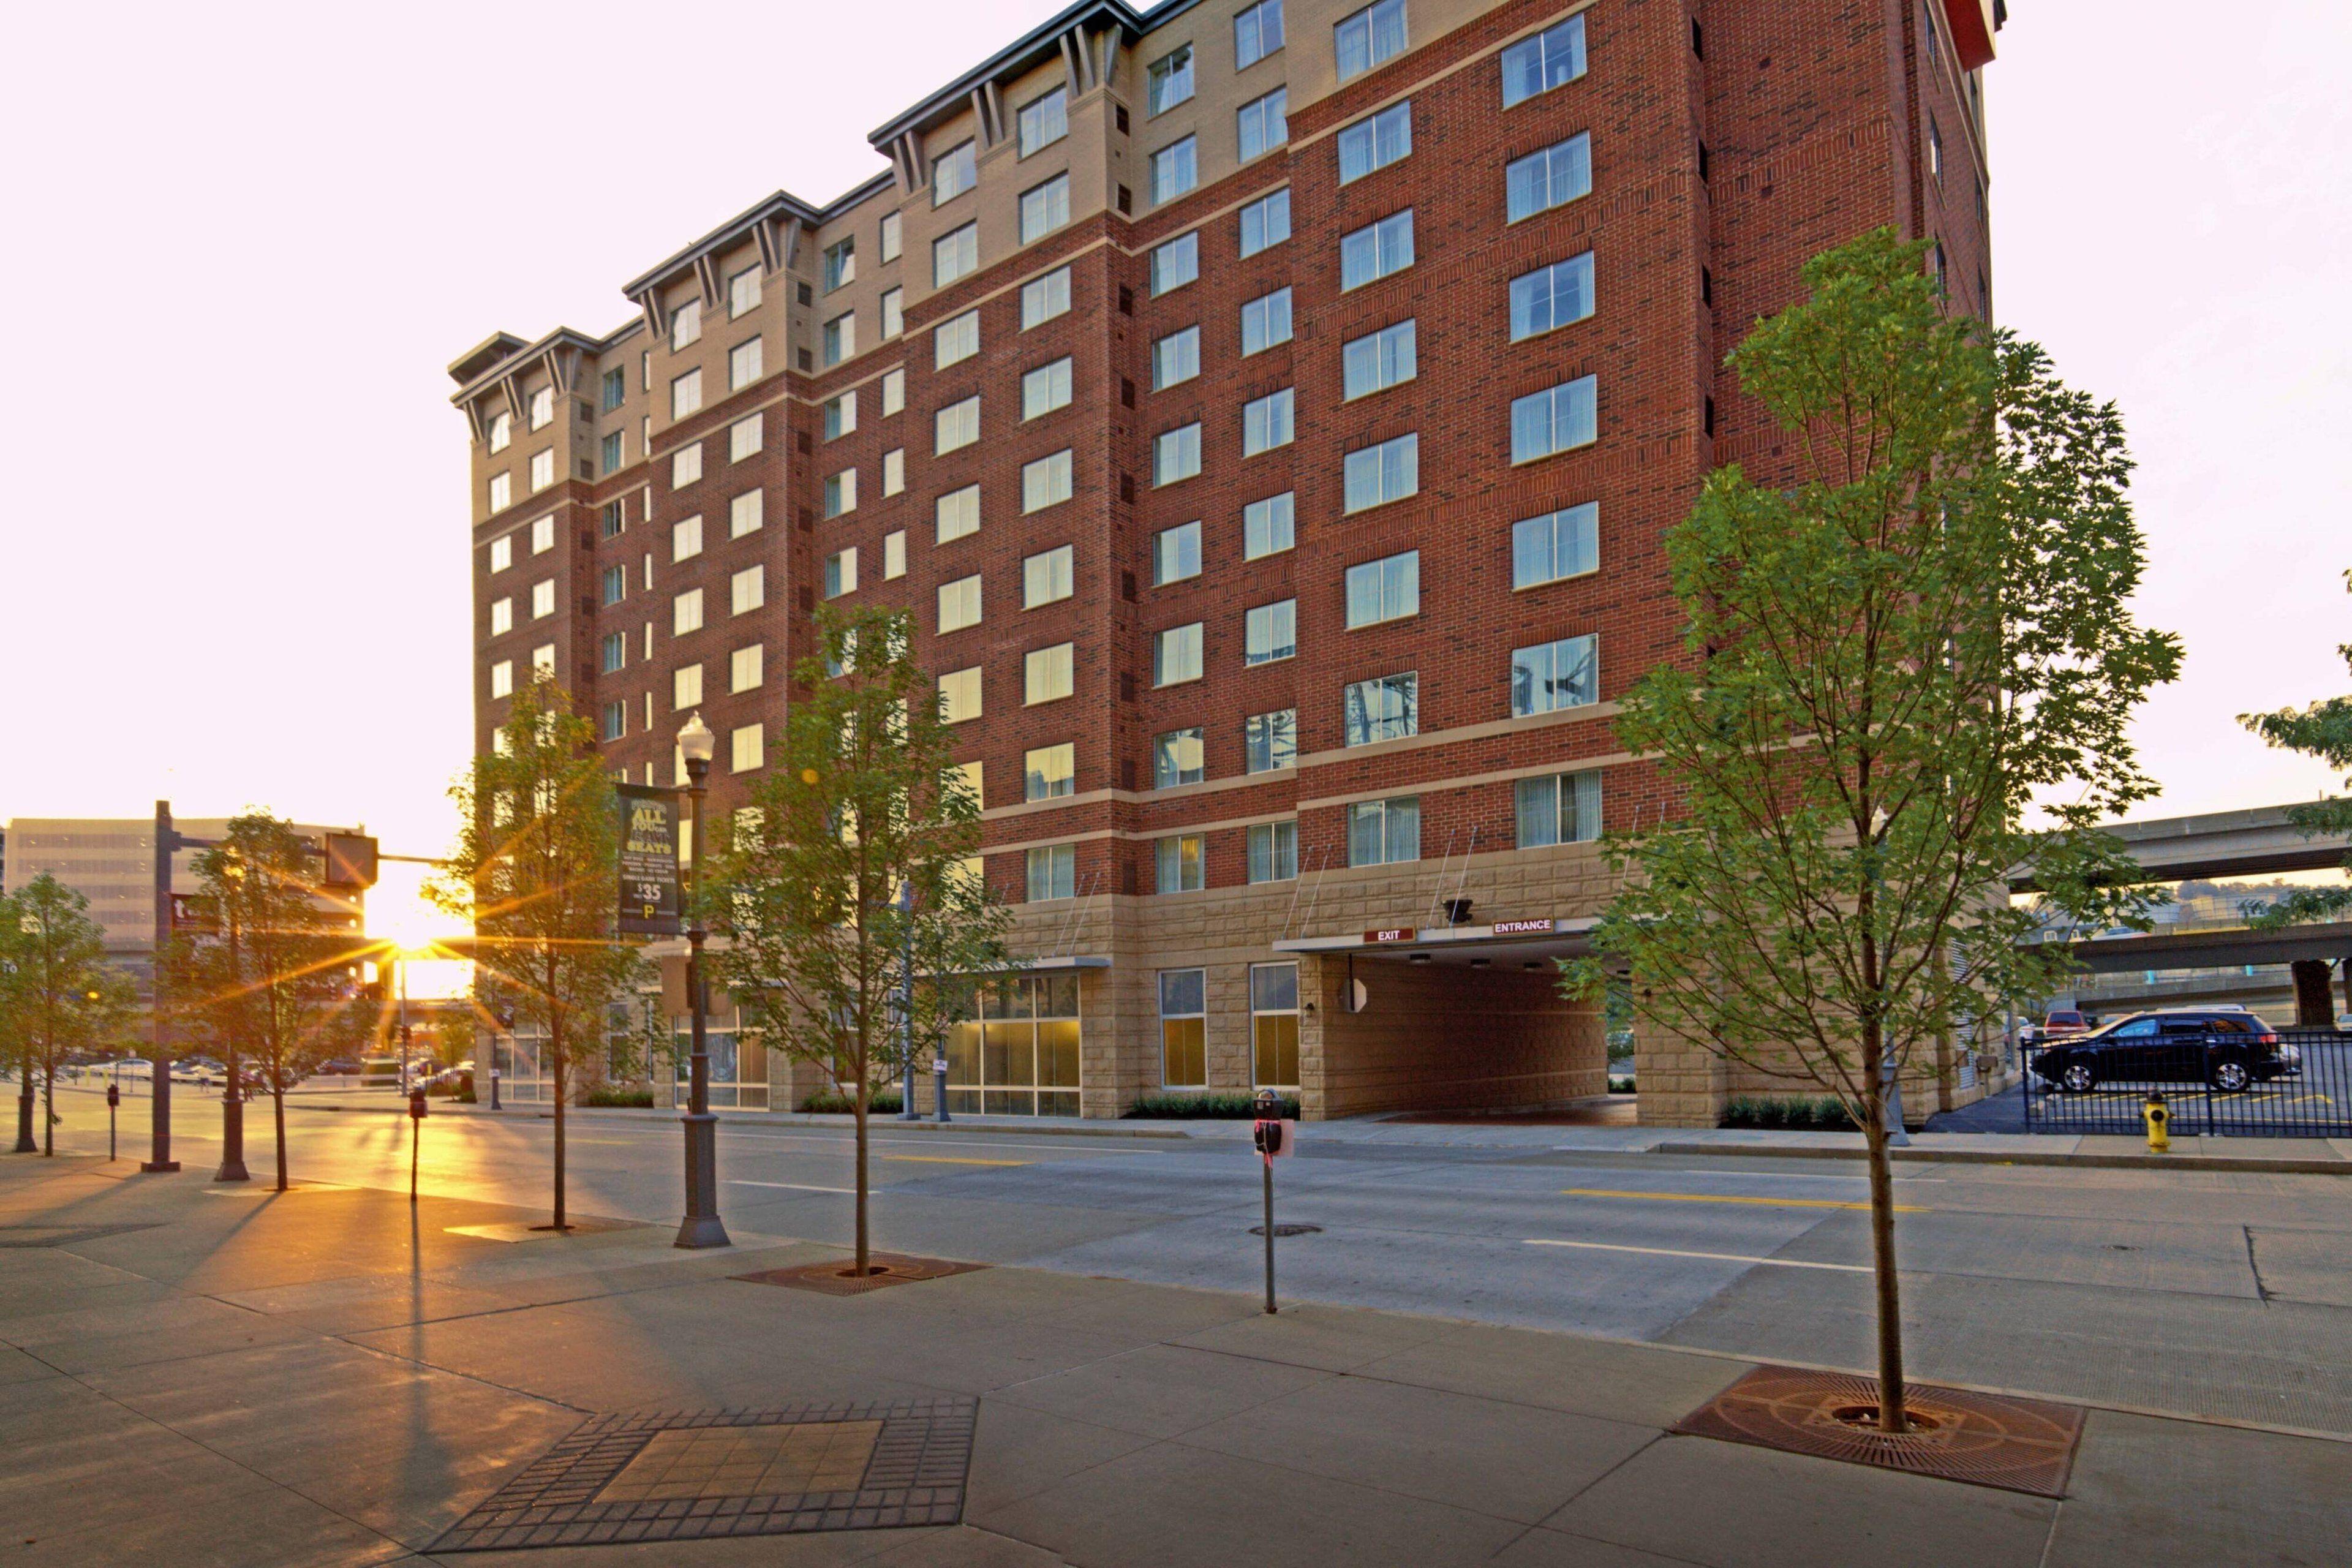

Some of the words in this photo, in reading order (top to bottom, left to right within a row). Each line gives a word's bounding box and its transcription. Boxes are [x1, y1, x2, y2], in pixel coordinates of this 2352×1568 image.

[632, 808, 666, 824] ALL
[632, 818, 654, 831] YOU
[627, 840, 672, 855] SEATS
[644, 905, 654, 919] P
[1495, 919, 1551, 932] ENTRANCE
[1378, 930, 1400, 941] EXIT
